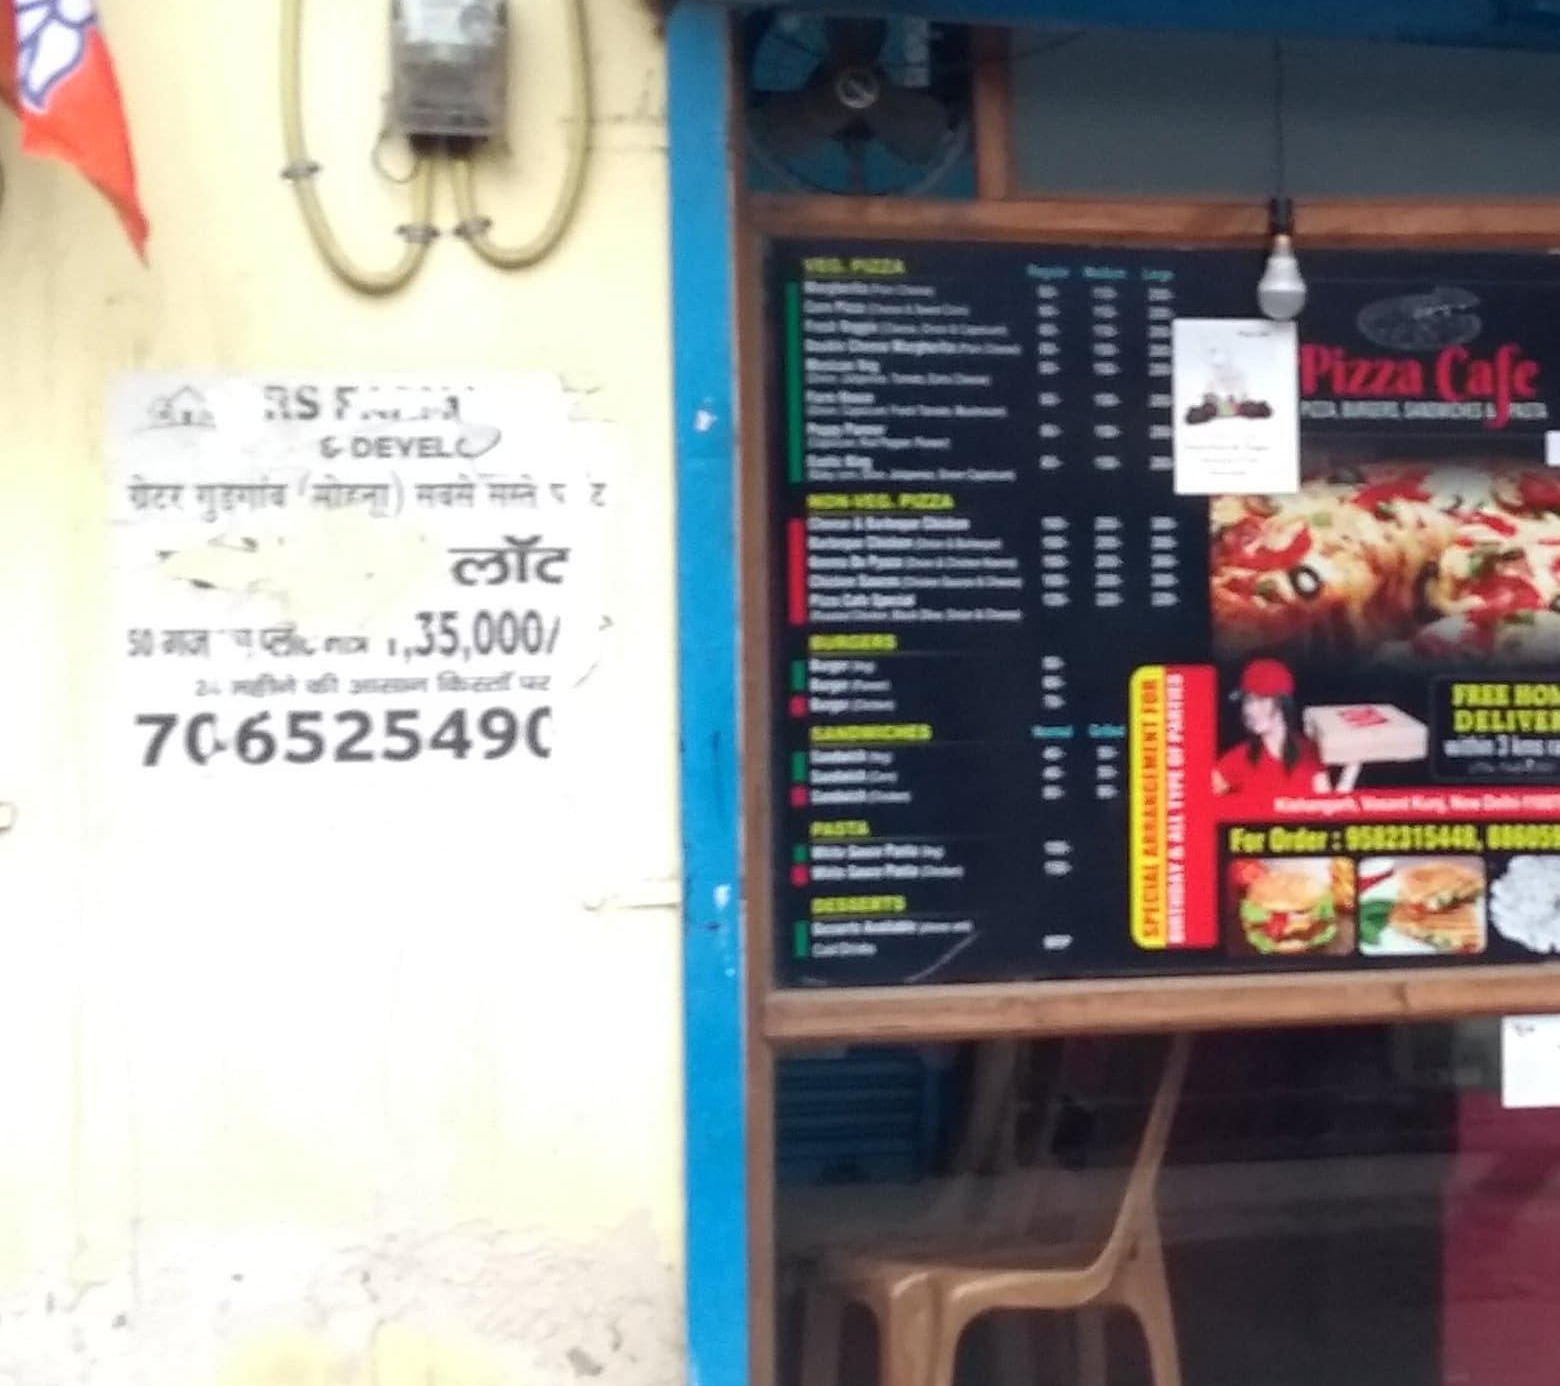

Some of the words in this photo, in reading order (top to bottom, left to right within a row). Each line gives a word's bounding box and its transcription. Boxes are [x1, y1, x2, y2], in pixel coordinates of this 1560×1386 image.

[1300, 344, 1423, 400] Pizza
[1434, 342, 1541, 430] Cafe
[1451, 682, 1511, 708] FREE
[1229, 827, 1266, 853] For
[1269, 825, 1329, 852] Order
